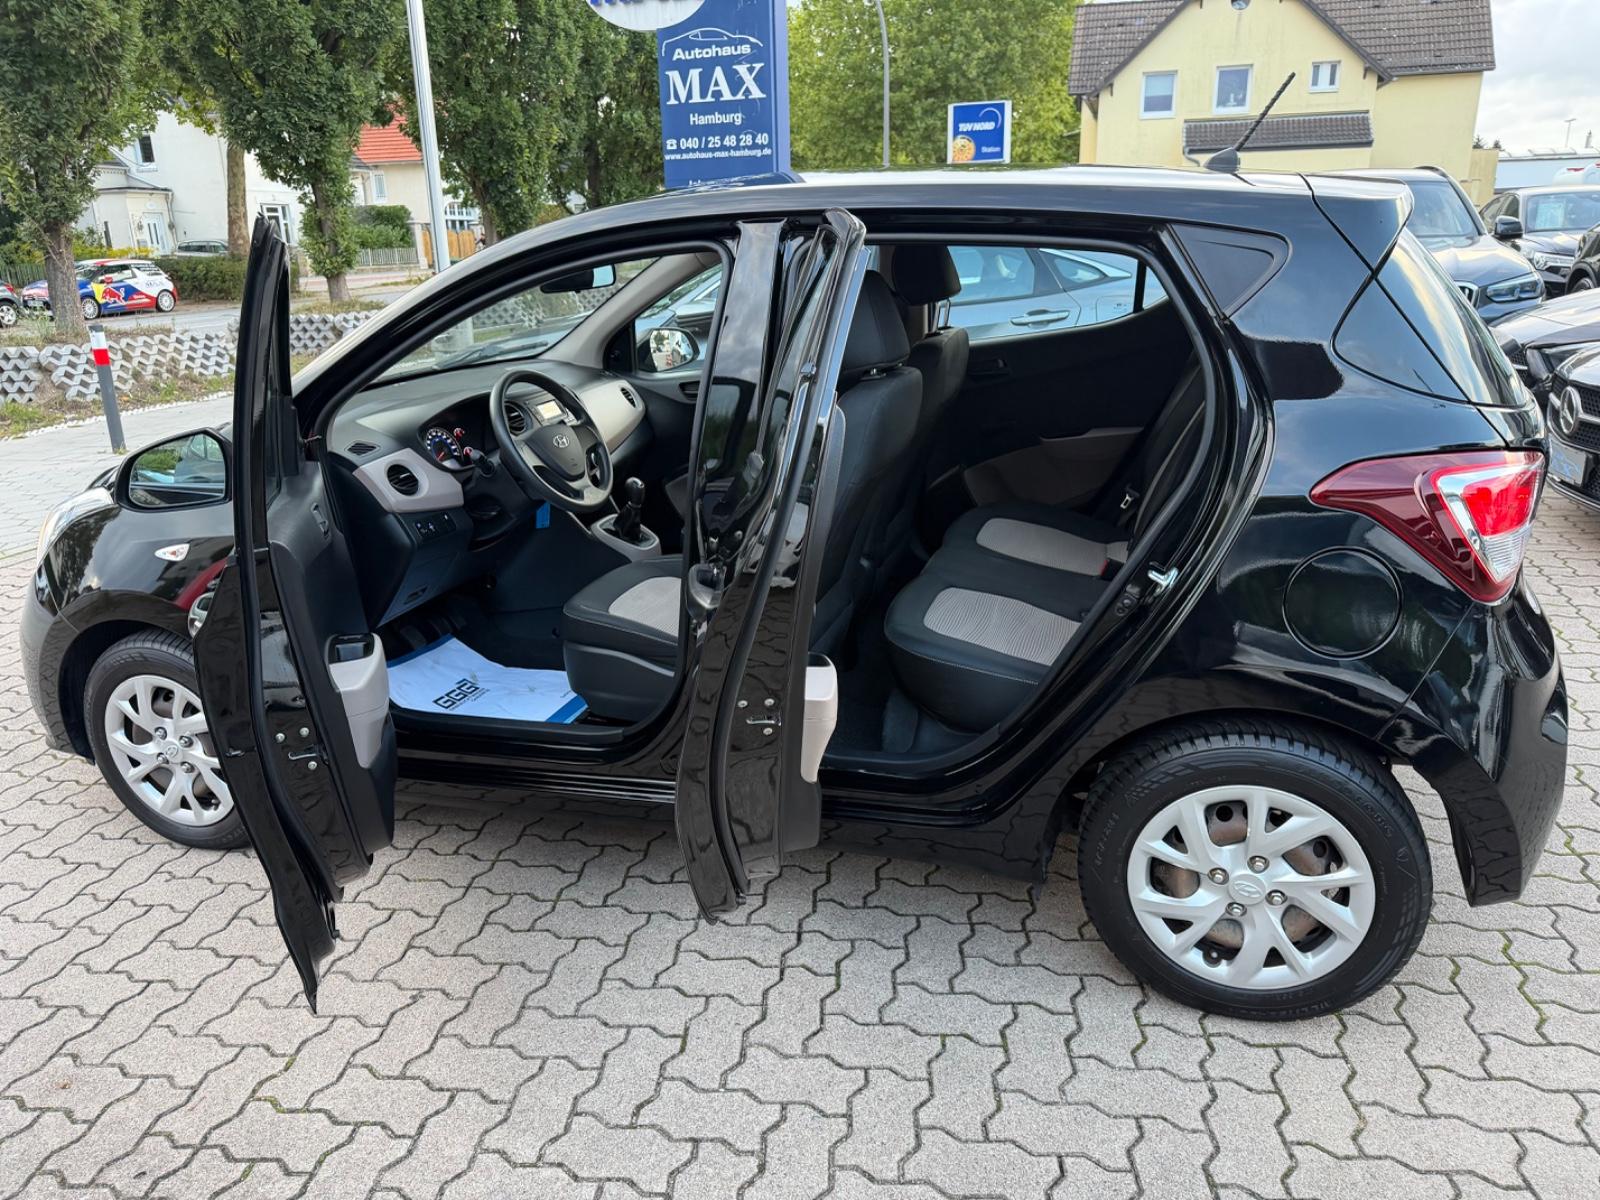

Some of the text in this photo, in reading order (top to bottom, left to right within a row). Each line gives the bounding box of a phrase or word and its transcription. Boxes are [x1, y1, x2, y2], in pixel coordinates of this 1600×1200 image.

[672, 44, 751, 61] Autohaus
[665, 63, 767, 105] MAX
[689, 112, 743, 125] Hamburg
[679, 133, 769, 150] 040 / 25 48 28 40
[664, 147, 772, 160] www.autohaus-max-hamburg.de
